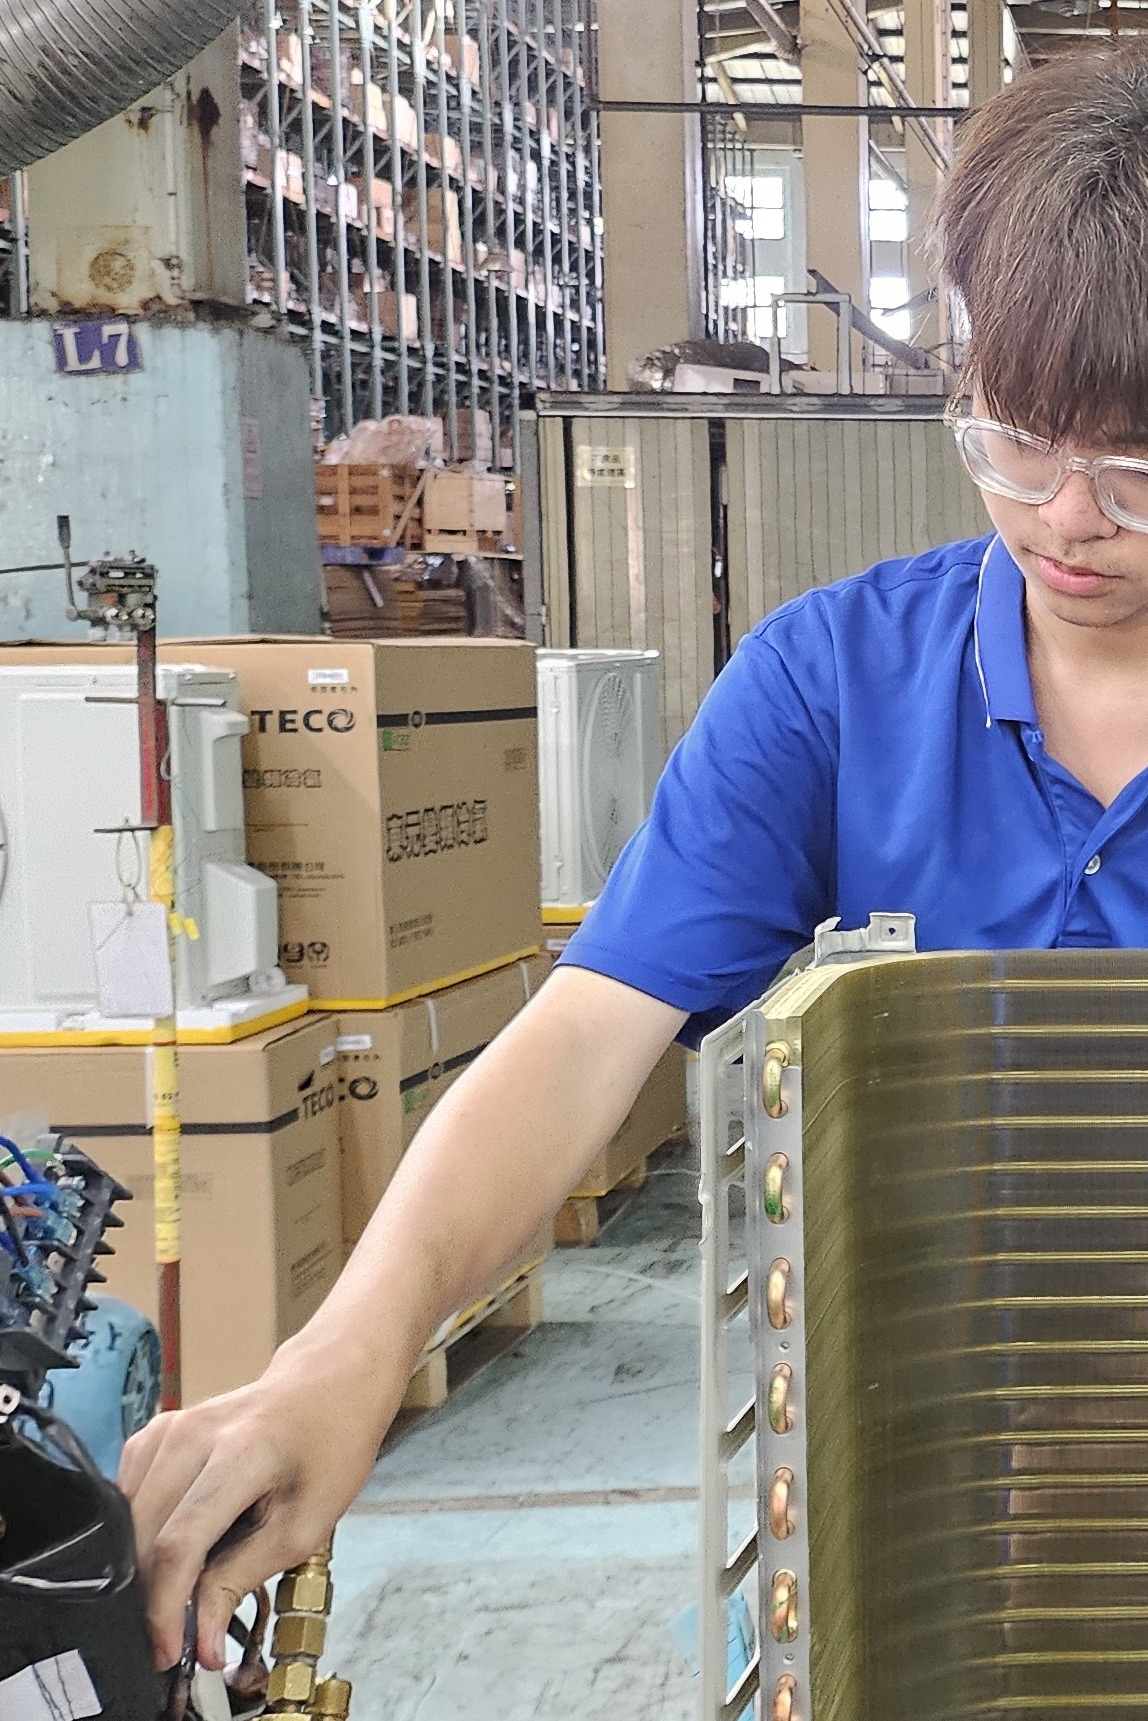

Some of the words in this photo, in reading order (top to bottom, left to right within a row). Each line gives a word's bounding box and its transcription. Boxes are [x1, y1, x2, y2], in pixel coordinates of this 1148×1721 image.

[56, 323, 130, 372] L7
[250, 709, 356, 734] TECO
[301, 1082, 335, 1121] TECO
